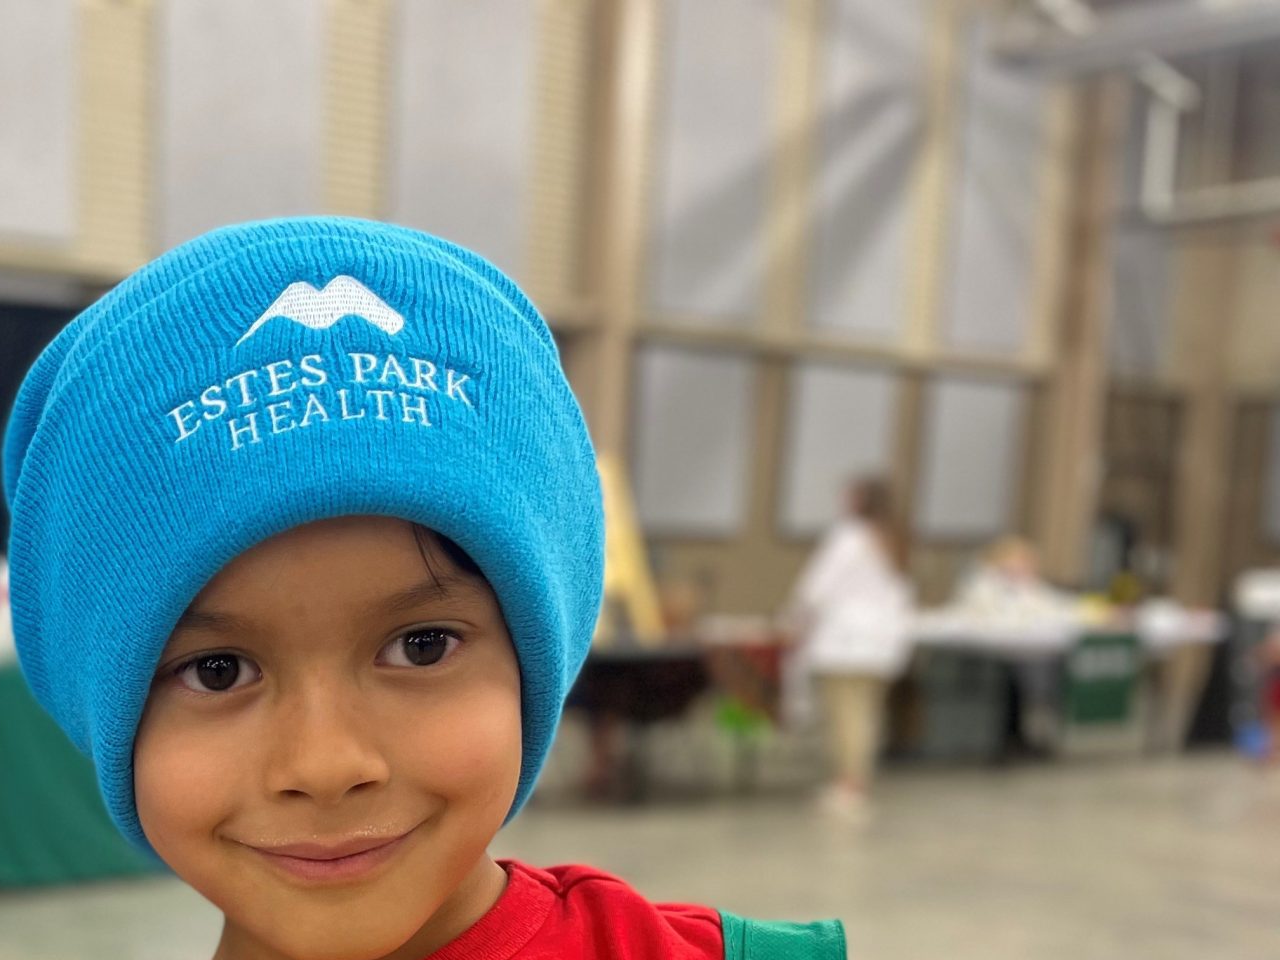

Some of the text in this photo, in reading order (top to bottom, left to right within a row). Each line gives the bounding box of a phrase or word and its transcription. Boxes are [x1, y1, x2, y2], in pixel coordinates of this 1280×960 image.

[167, 353, 475, 442] ESTES PARK
[228, 390, 432, 451] HEALTH
